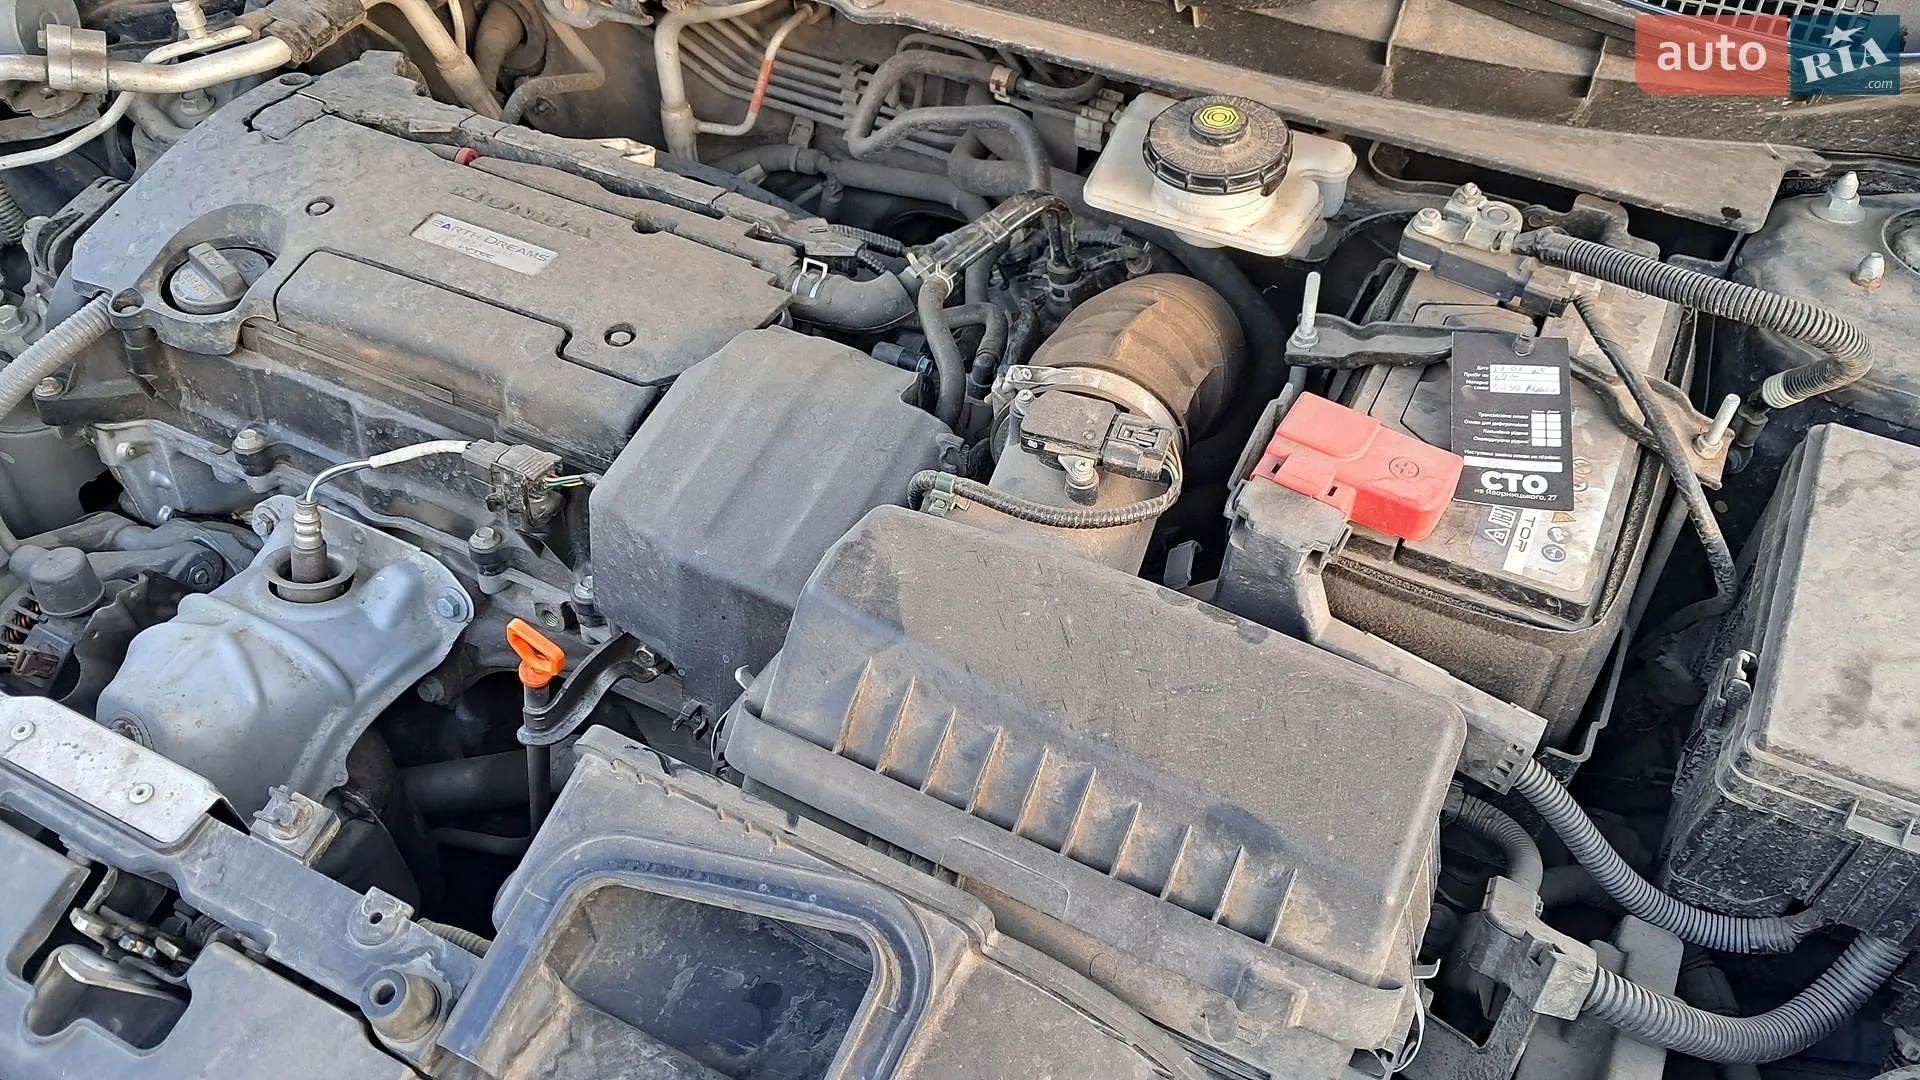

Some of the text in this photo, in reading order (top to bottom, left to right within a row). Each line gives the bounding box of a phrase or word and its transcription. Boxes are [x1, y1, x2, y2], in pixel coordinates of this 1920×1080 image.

[431, 218, 551, 263] EARTH DREAMS
[1480, 470, 1549, 495] СТО
